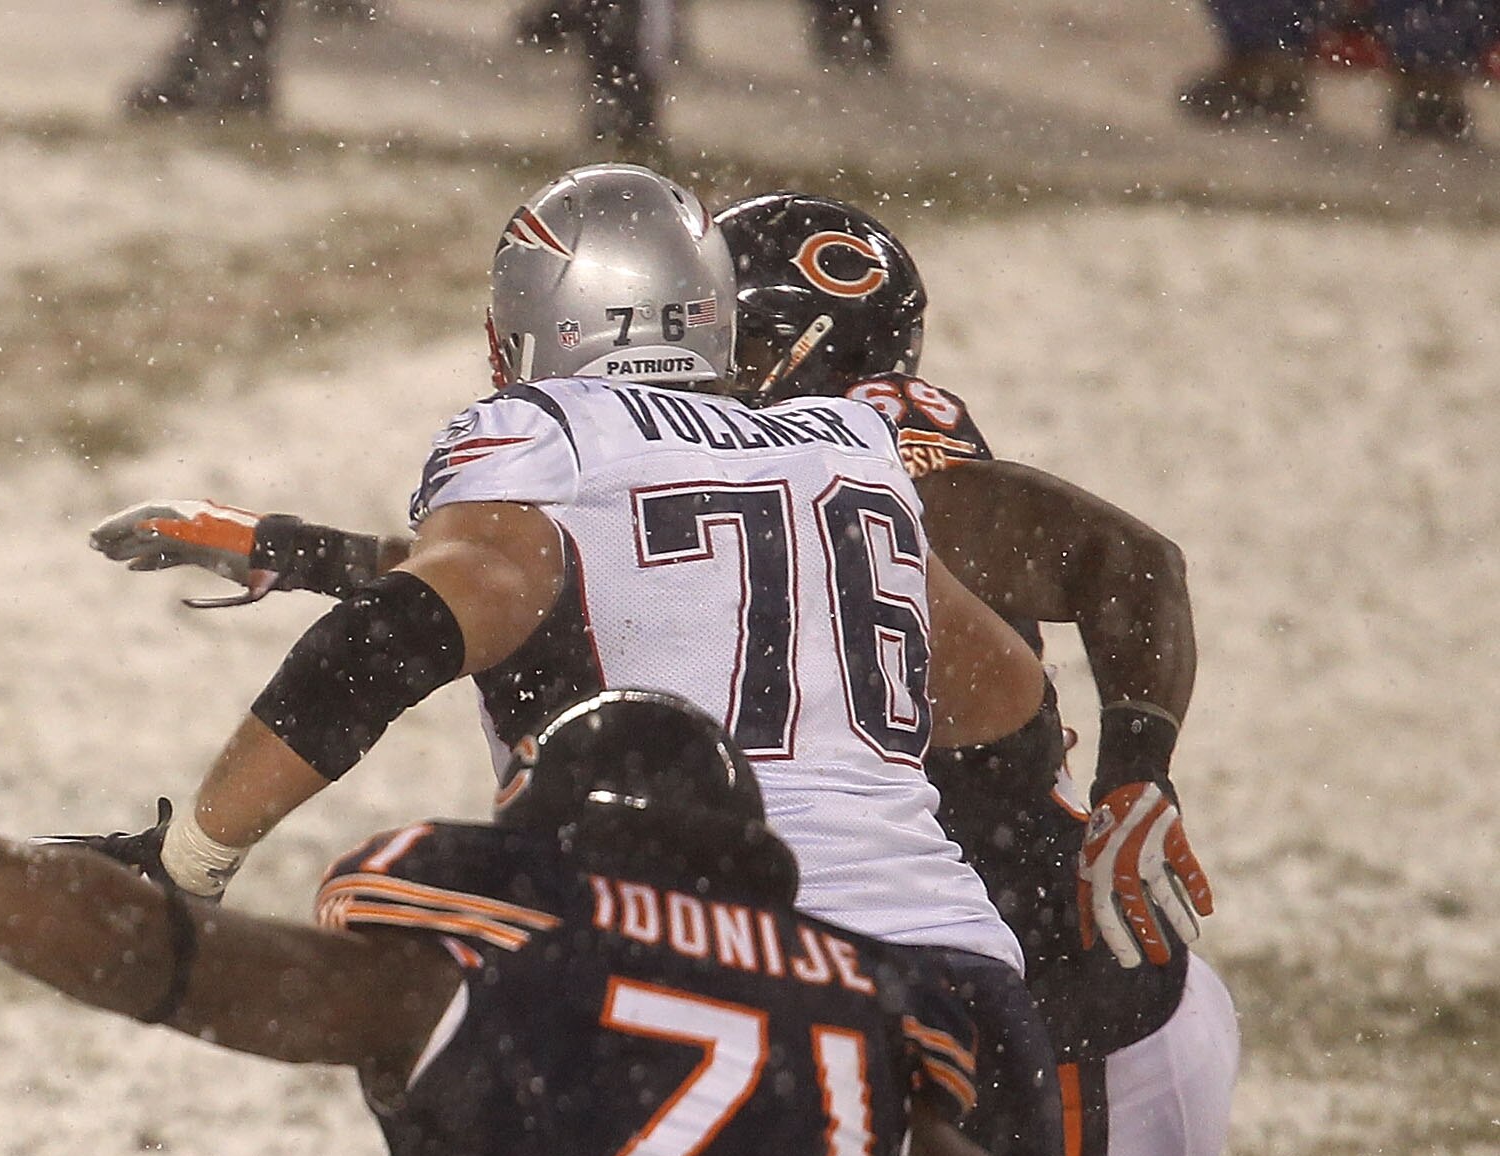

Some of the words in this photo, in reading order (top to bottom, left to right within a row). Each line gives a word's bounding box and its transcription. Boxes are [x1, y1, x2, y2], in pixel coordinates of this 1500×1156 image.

[607, 357, 695, 375] PATRIOTS
[603, 386, 870, 450] VOLLMER
[630, 473, 932, 769] 76
[589, 875, 877, 996] IDONIJE
